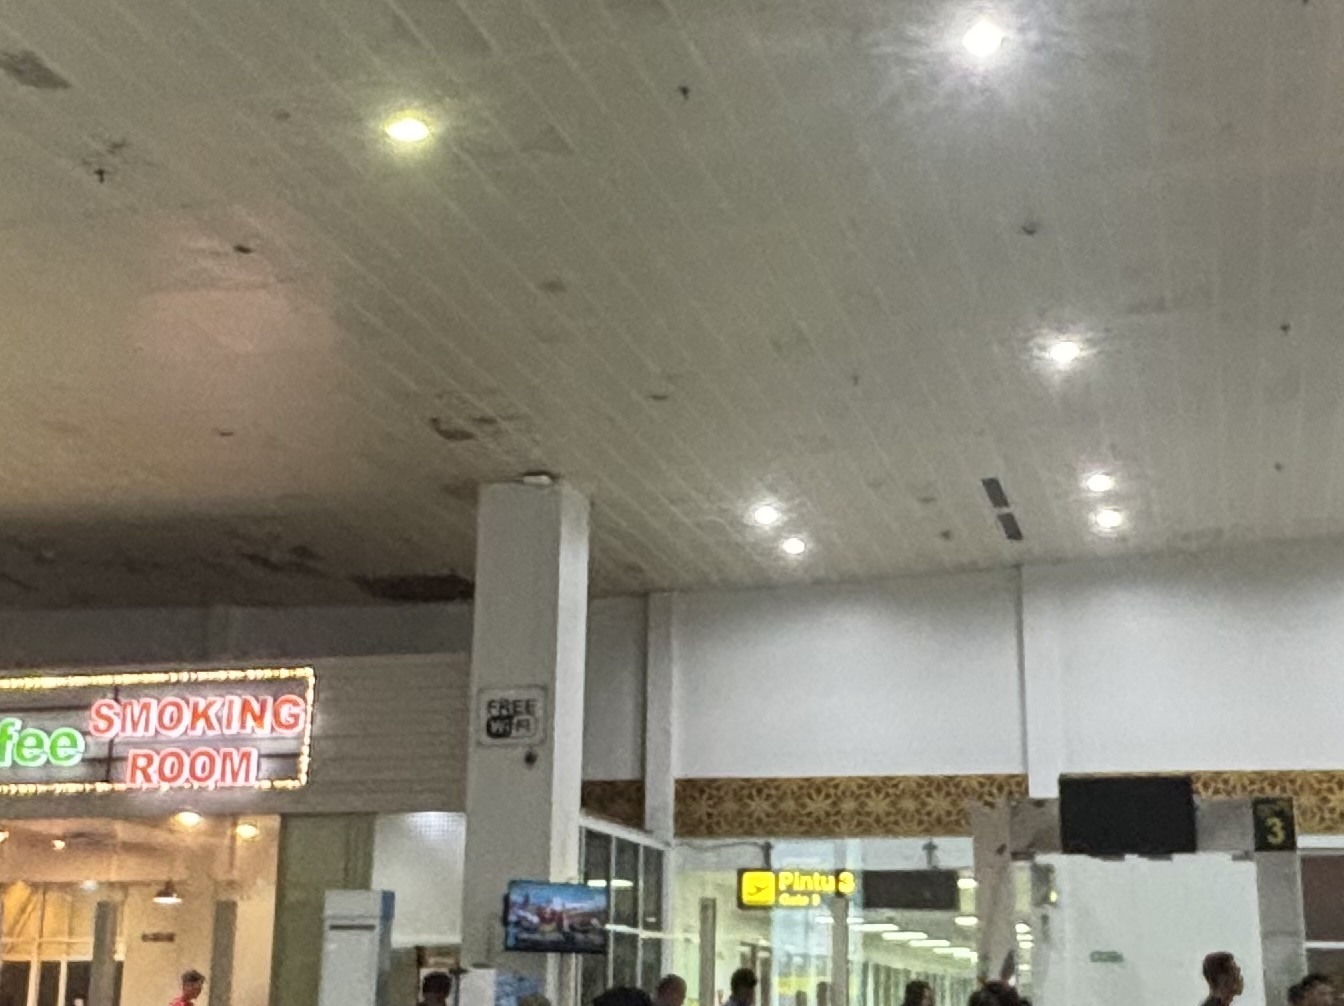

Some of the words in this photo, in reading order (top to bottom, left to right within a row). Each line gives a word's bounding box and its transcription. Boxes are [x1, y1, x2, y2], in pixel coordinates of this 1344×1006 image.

[89, 694, 306, 738] SMOKING
[487, 698, 536, 715] FREE
[126, 747, 258, 788] ROOM
[1266, 817, 1285, 845] 3
[778, 871, 836, 892] Pintu
[838, 871, 855, 893] 3
